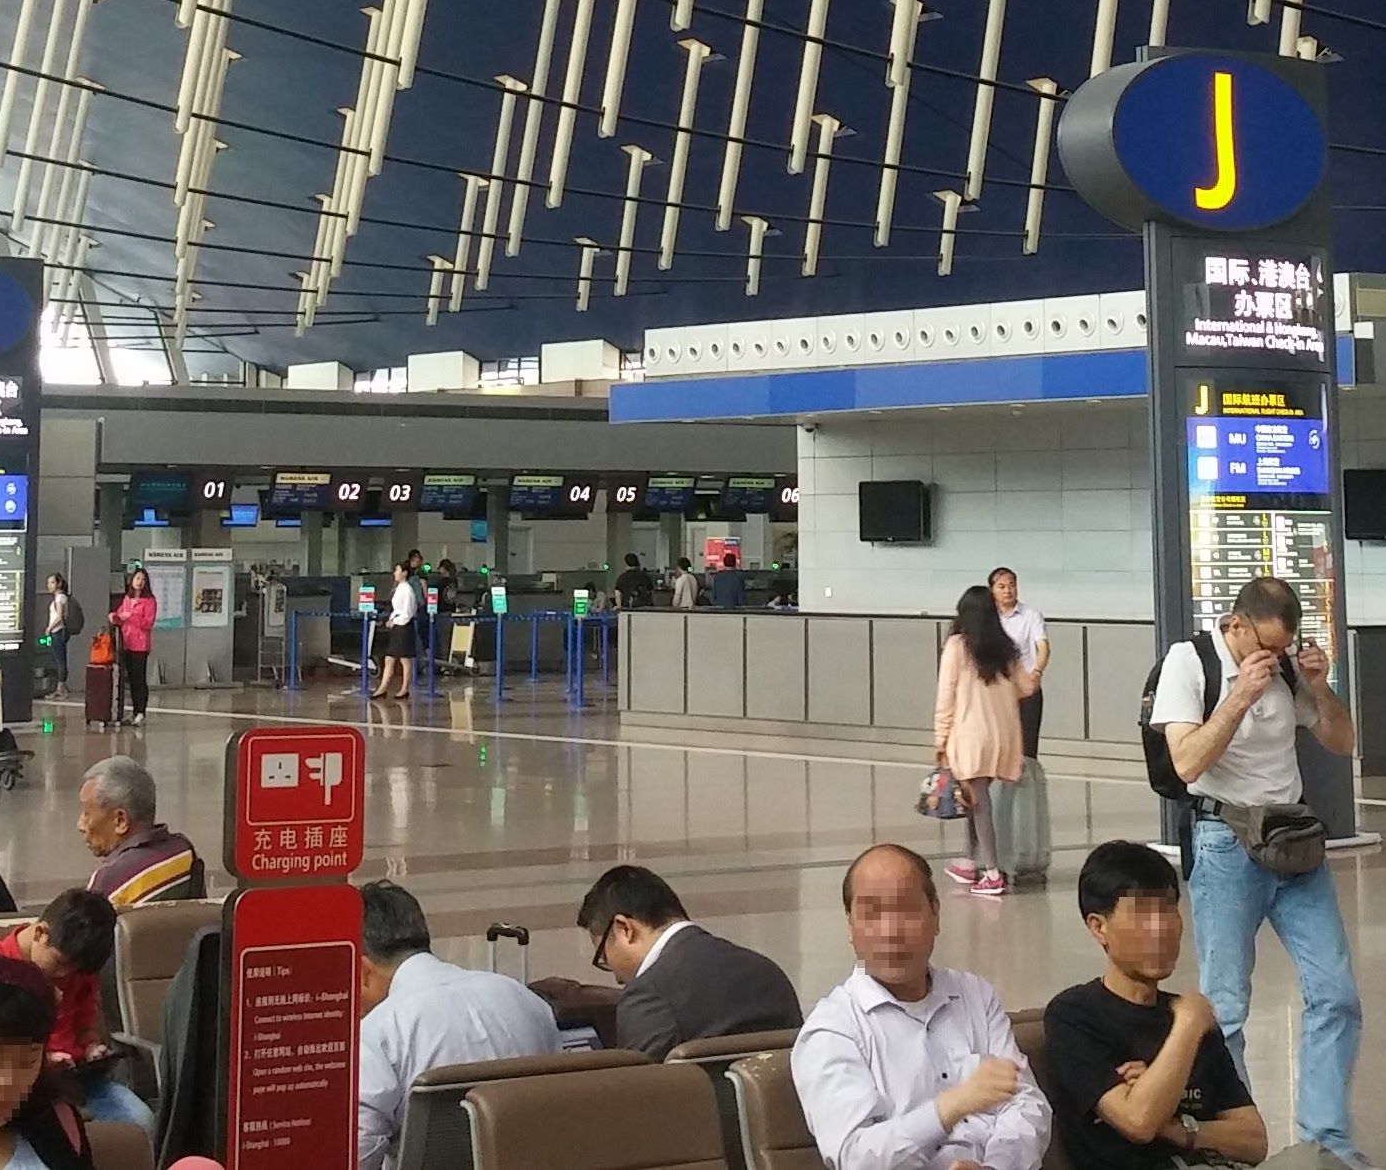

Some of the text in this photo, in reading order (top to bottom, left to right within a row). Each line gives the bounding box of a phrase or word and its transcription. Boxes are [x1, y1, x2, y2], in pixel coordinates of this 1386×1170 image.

[1196, 73, 1235, 209] J
[1234, 289, 1293, 319] 办票区
[1195, 318, 1264, 334] International
[1195, 385, 1208, 415] J
[203, 481, 225, 498] 01
[339, 483, 360, 500] 02
[389, 484, 411, 501] 03
[570, 485, 590, 502] 04
[616, 486, 637, 502] 05
[254, 825, 349, 851] 充电插座
[252, 851, 348, 873] Charging point
